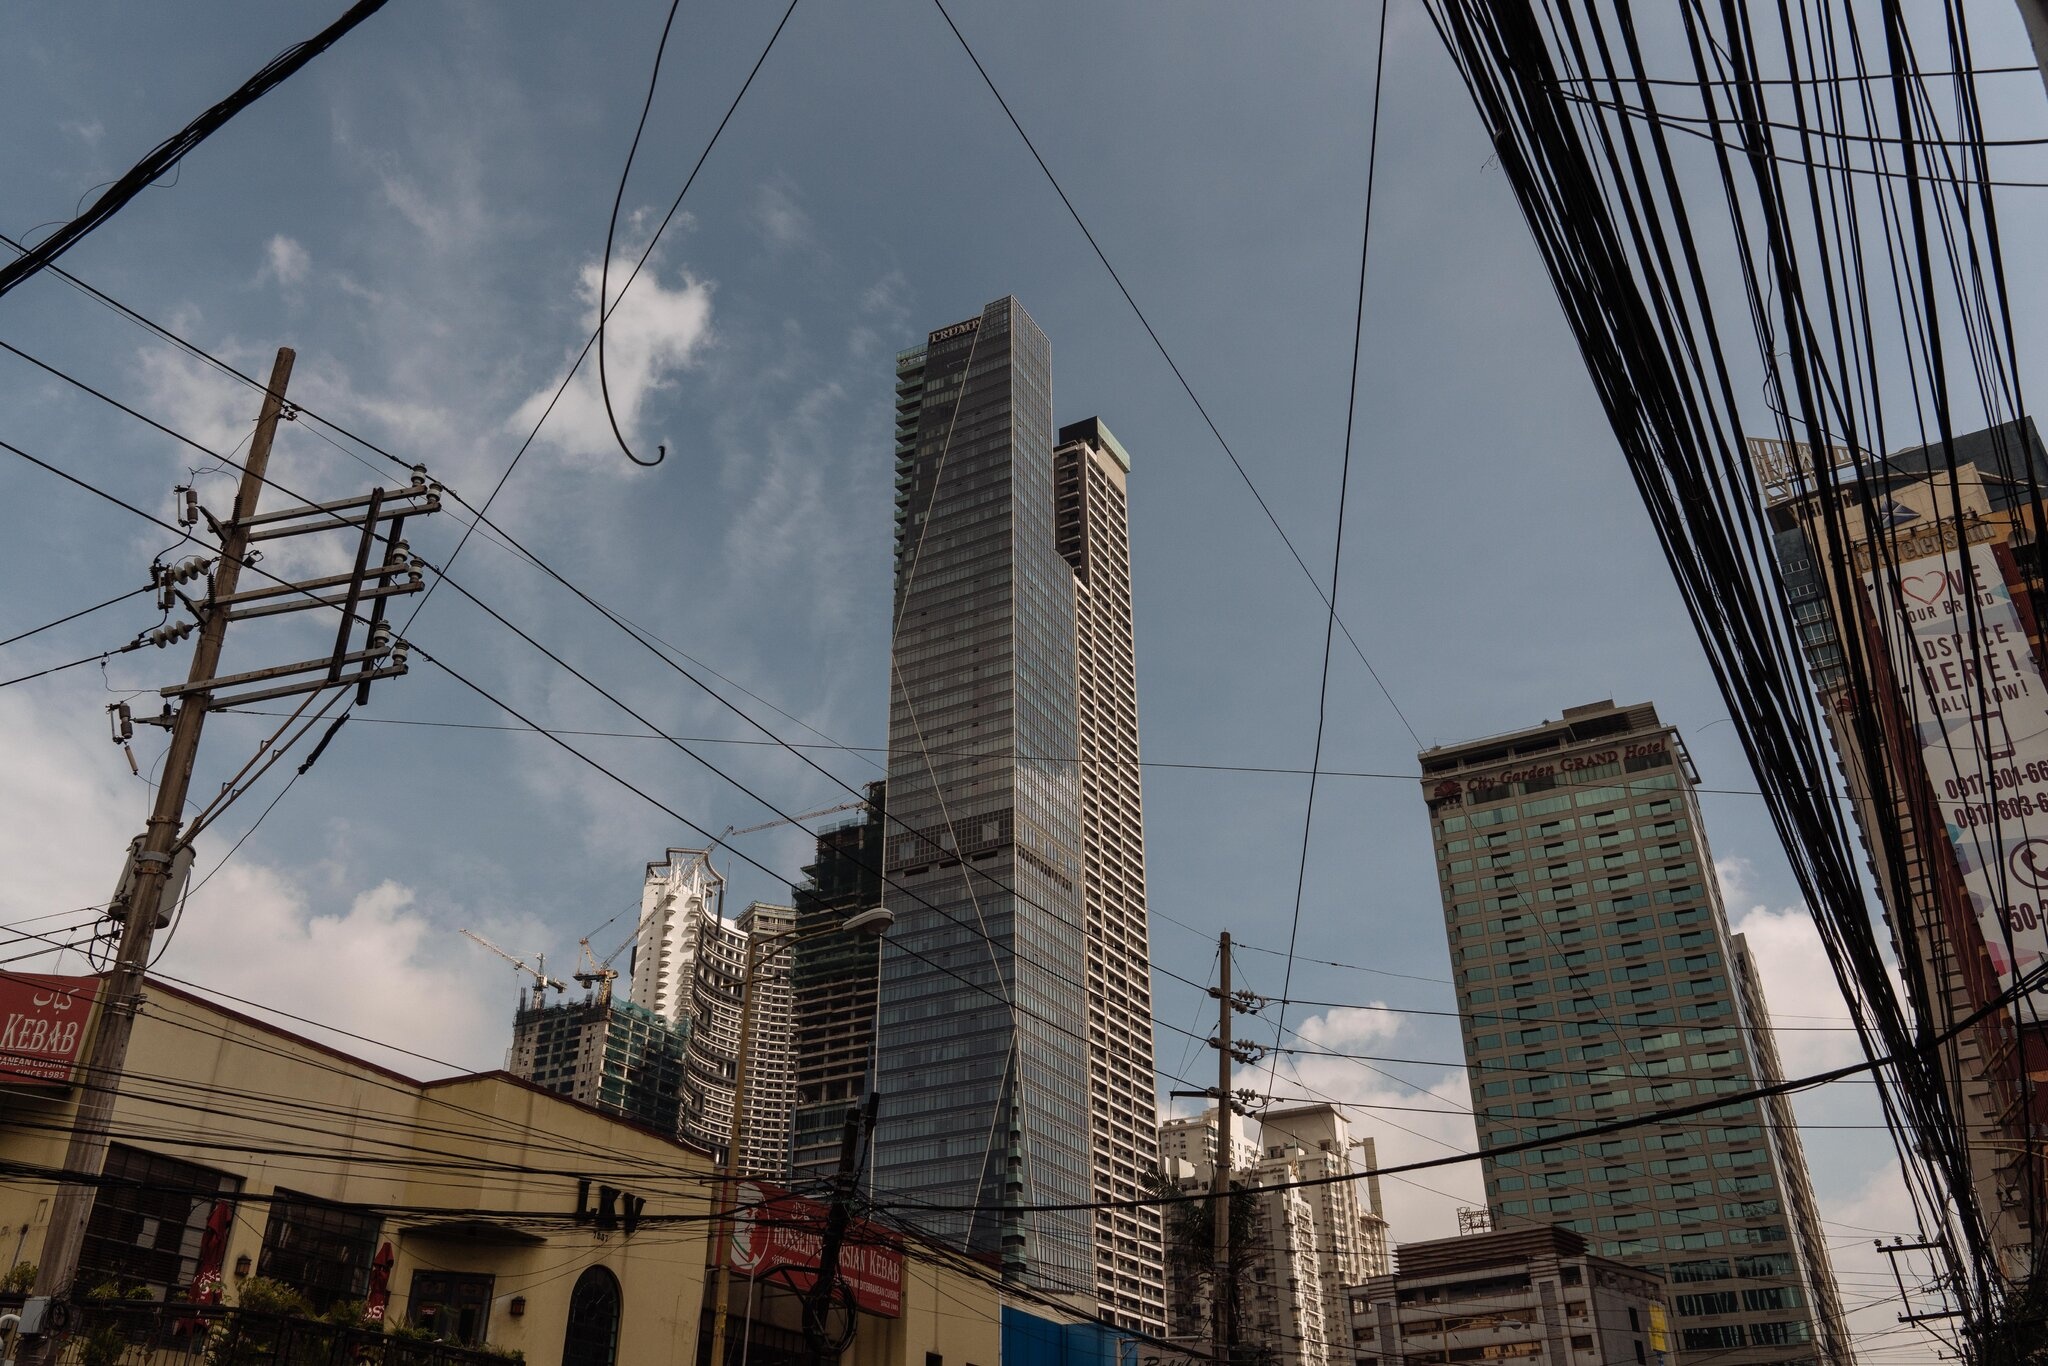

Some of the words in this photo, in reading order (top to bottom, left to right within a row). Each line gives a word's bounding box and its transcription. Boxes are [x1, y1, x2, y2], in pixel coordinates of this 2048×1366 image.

[930, 318, 980, 344] TRUMP
[1943, 592, 1995, 615] BRND
[1466, 776, 1496, 793] City
[1500, 764, 1555, 784] Garden
[1560, 749, 1619, 772] GRAND
[1624, 737, 1667, 760] Hotel
[33, 987, 81, 1016] کباب
[0, 1013, 79, 1055] KEBAB
[0, 1055, 32, 1068] ANEAN
[43, 1071, 65, 1079] 1985
[869, 1250, 900, 1283] KEBAB
